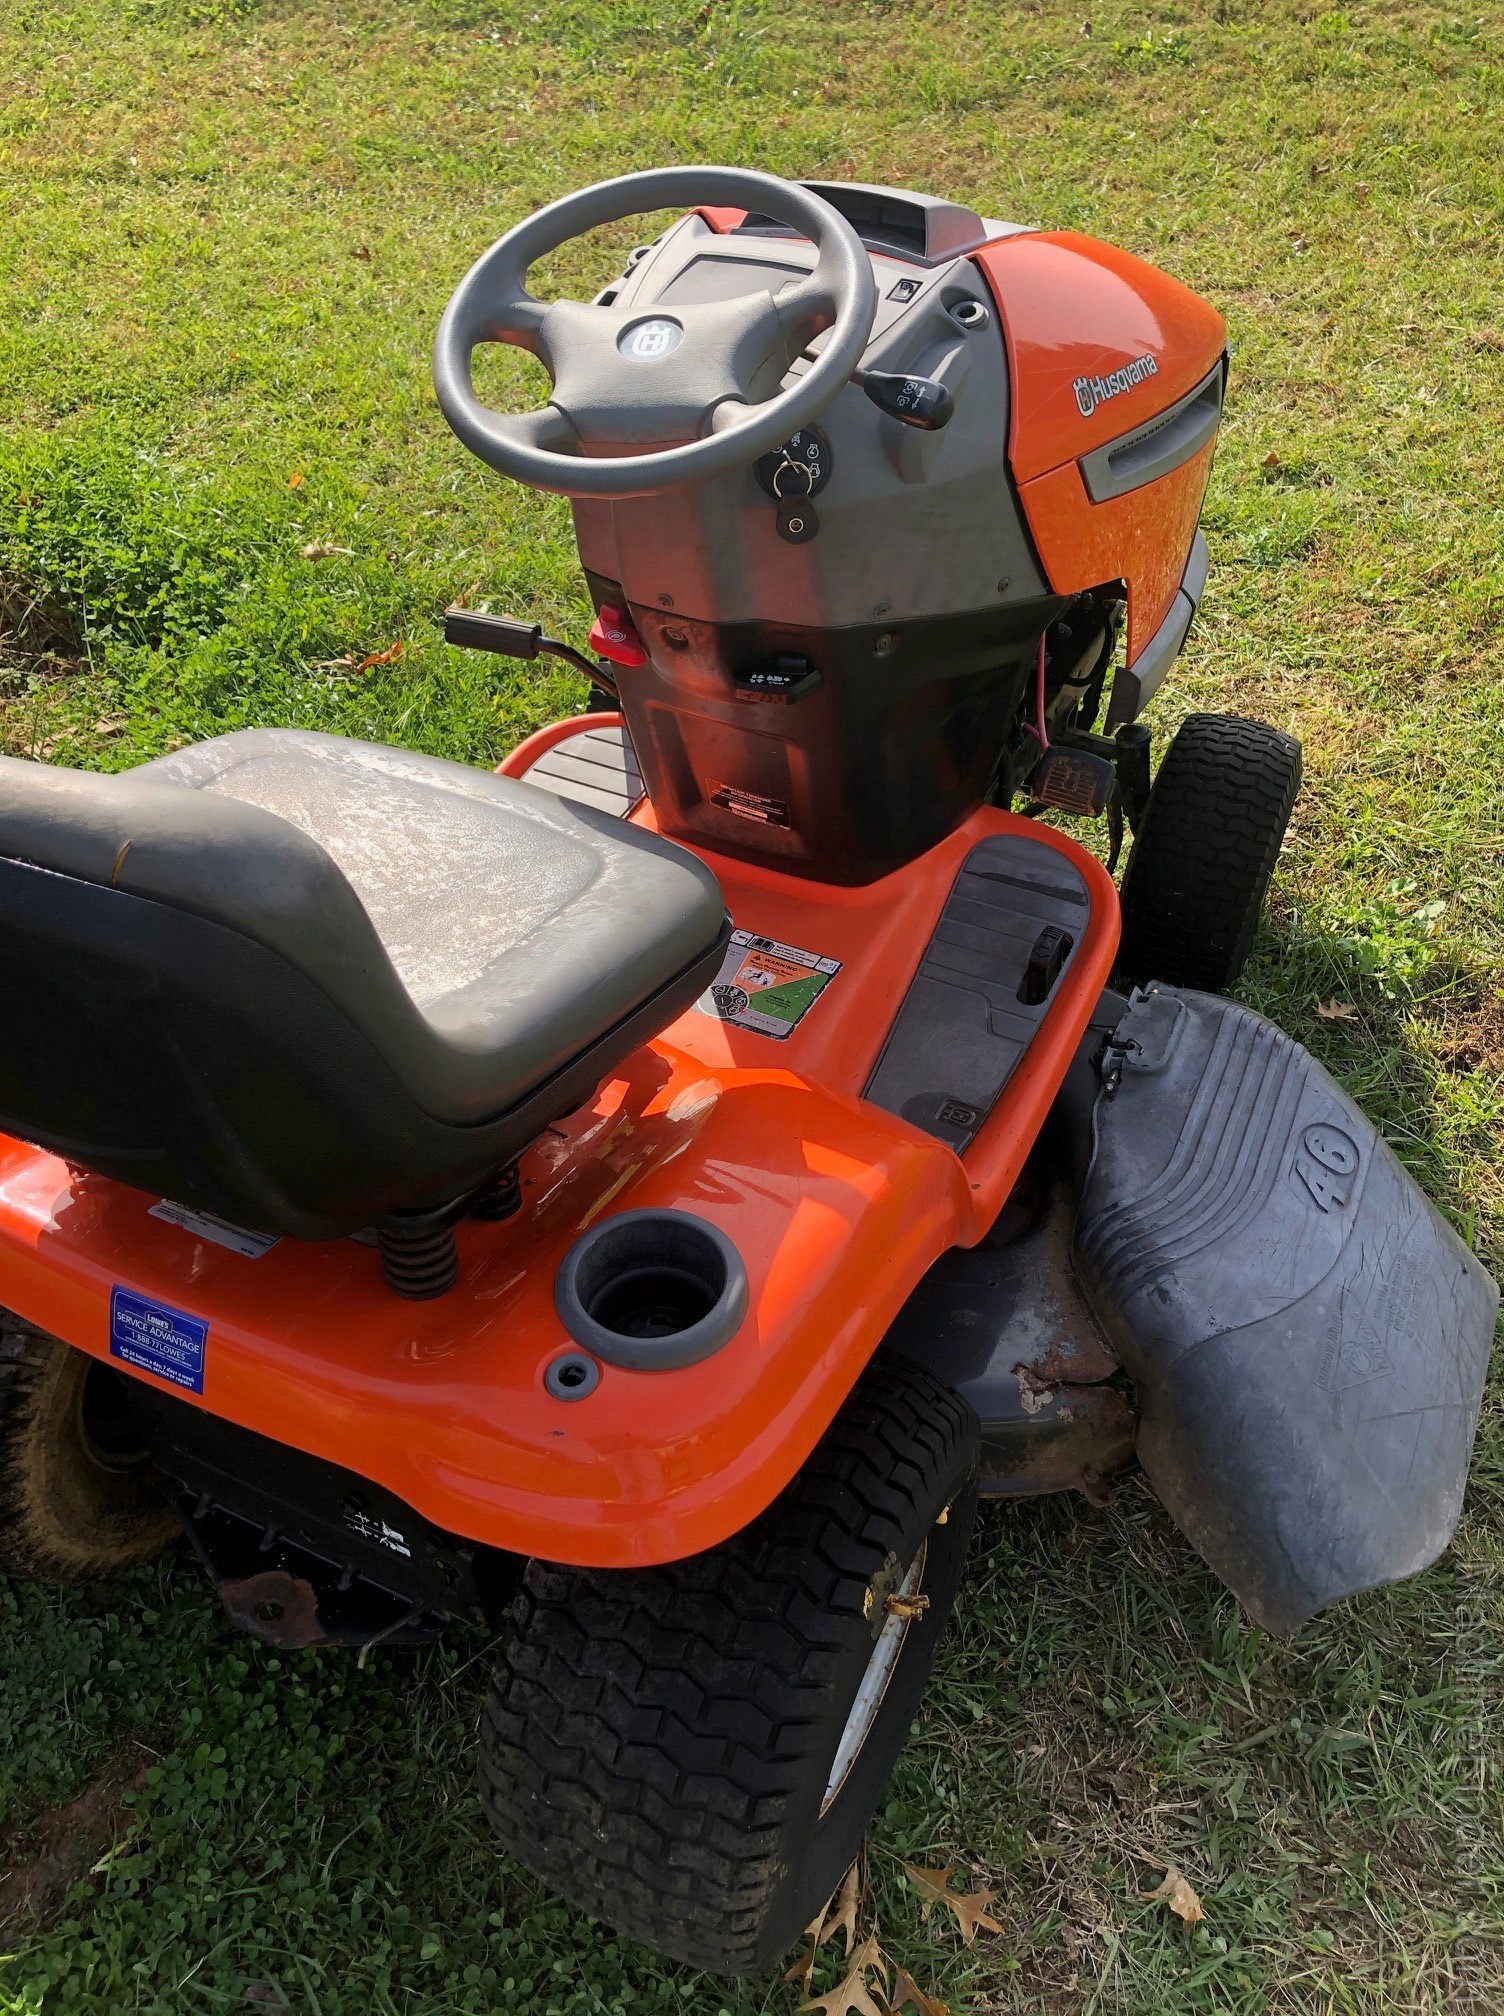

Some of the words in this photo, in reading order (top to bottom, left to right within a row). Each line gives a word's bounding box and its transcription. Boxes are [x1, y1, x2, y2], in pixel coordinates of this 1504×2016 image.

[1089, 354, 1159, 405] Husqvarna
[764, 957, 798, 972] WARNING
[1296, 1123, 1358, 1214] 46
[116, 1311, 148, 1332] SERVICE
[149, 1326, 200, 1354] ADVANTAGE
[119, 1346, 129, 1354] Call
[135, 1351, 149, 1362] hours
